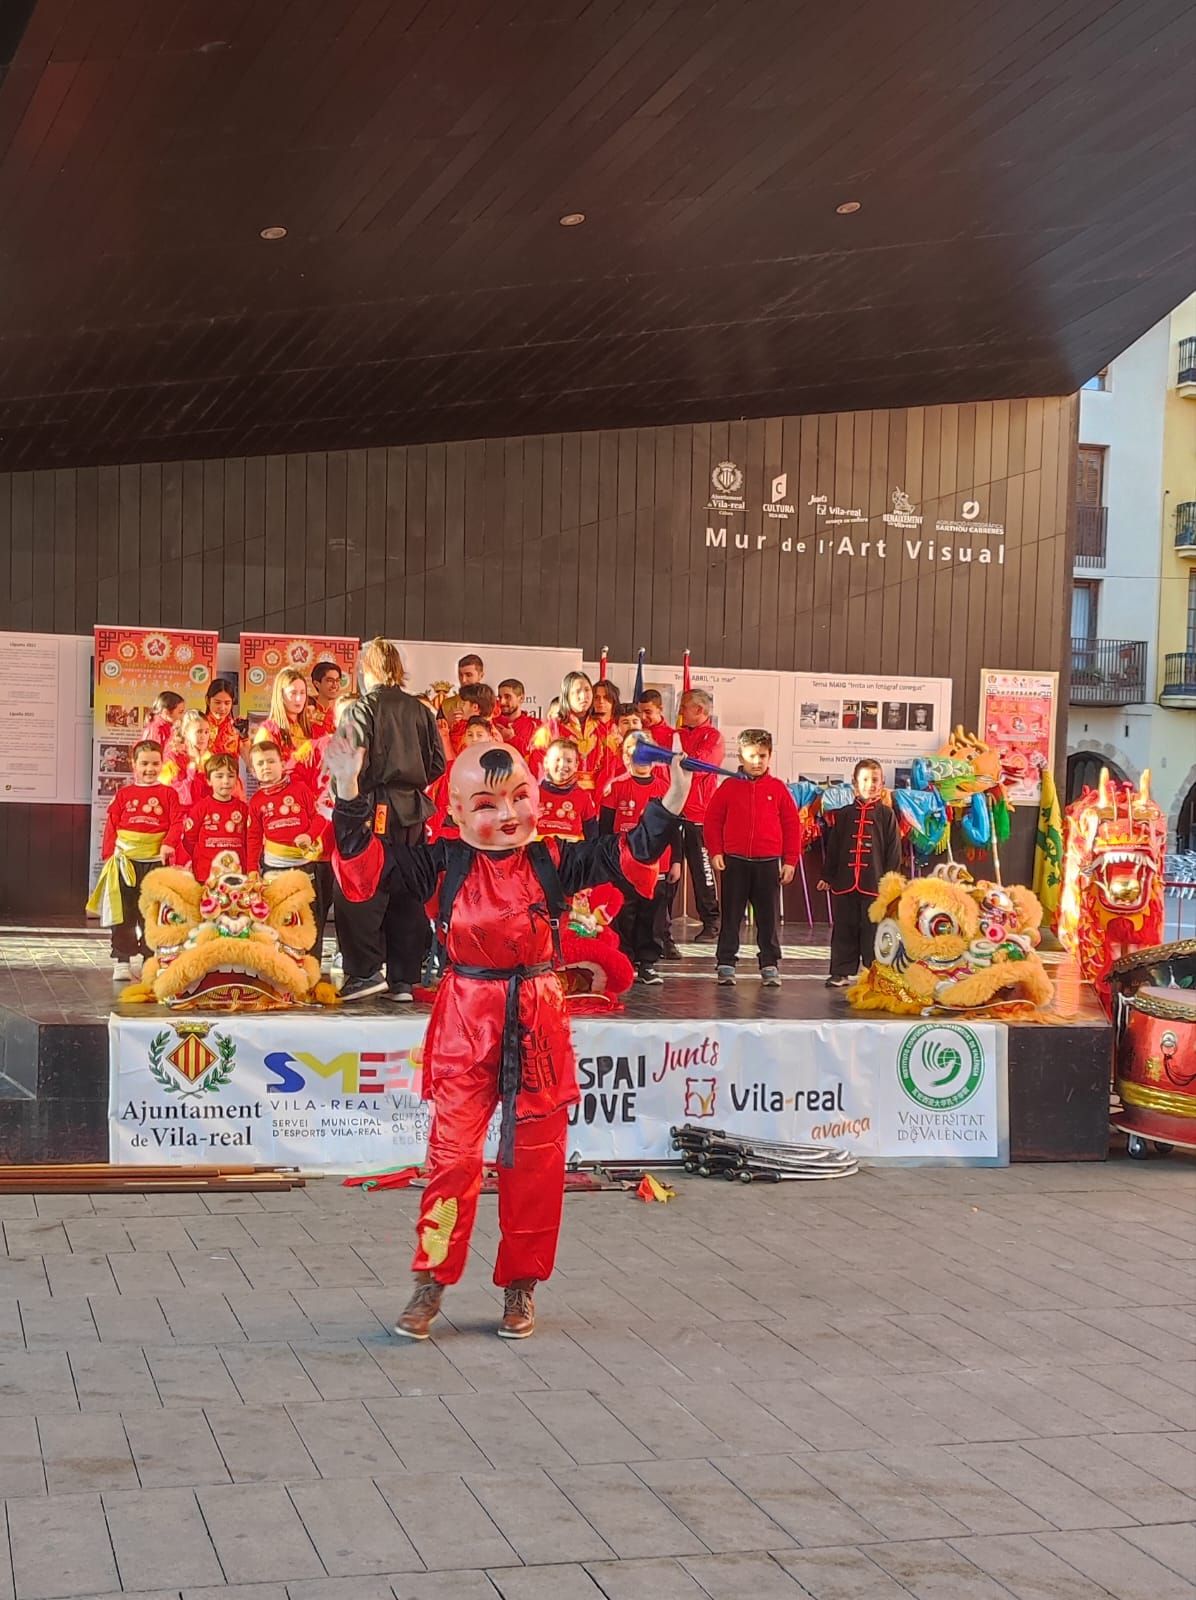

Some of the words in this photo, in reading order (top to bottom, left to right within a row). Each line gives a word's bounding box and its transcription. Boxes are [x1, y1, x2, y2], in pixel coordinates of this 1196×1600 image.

[712, 500, 746, 509] Vila-real
[762, 503, 795, 514] CULTURA
[828, 506, 862, 517] Vila-real
[705, 527, 767, 550] Mur
[782, 537, 806, 553] de
[819, 536, 886, 558] l'Art
[906, 540, 1005, 564] Visual
[828, 681, 847, 689] MAIG
[652, 1036, 720, 1083] Junts
[578, 1055, 646, 1090] SPAI
[271, 1099, 381, 1111] VILA-REAL
[730, 1082, 845, 1112] Vila-real
[121, 1100, 263, 1127] Ajuntament
[272, 1119, 309, 1128] SERVEI
[321, 1118, 382, 1127] MUNICIPAL
[811, 1115, 871, 1140] avança
[130, 1133, 149, 1147] de
[149, 1126, 253, 1148] Vila-real
[272, 1128, 326, 1138] D'ESPORTS
[331, 1129, 382, 1137] VILA-REAL
